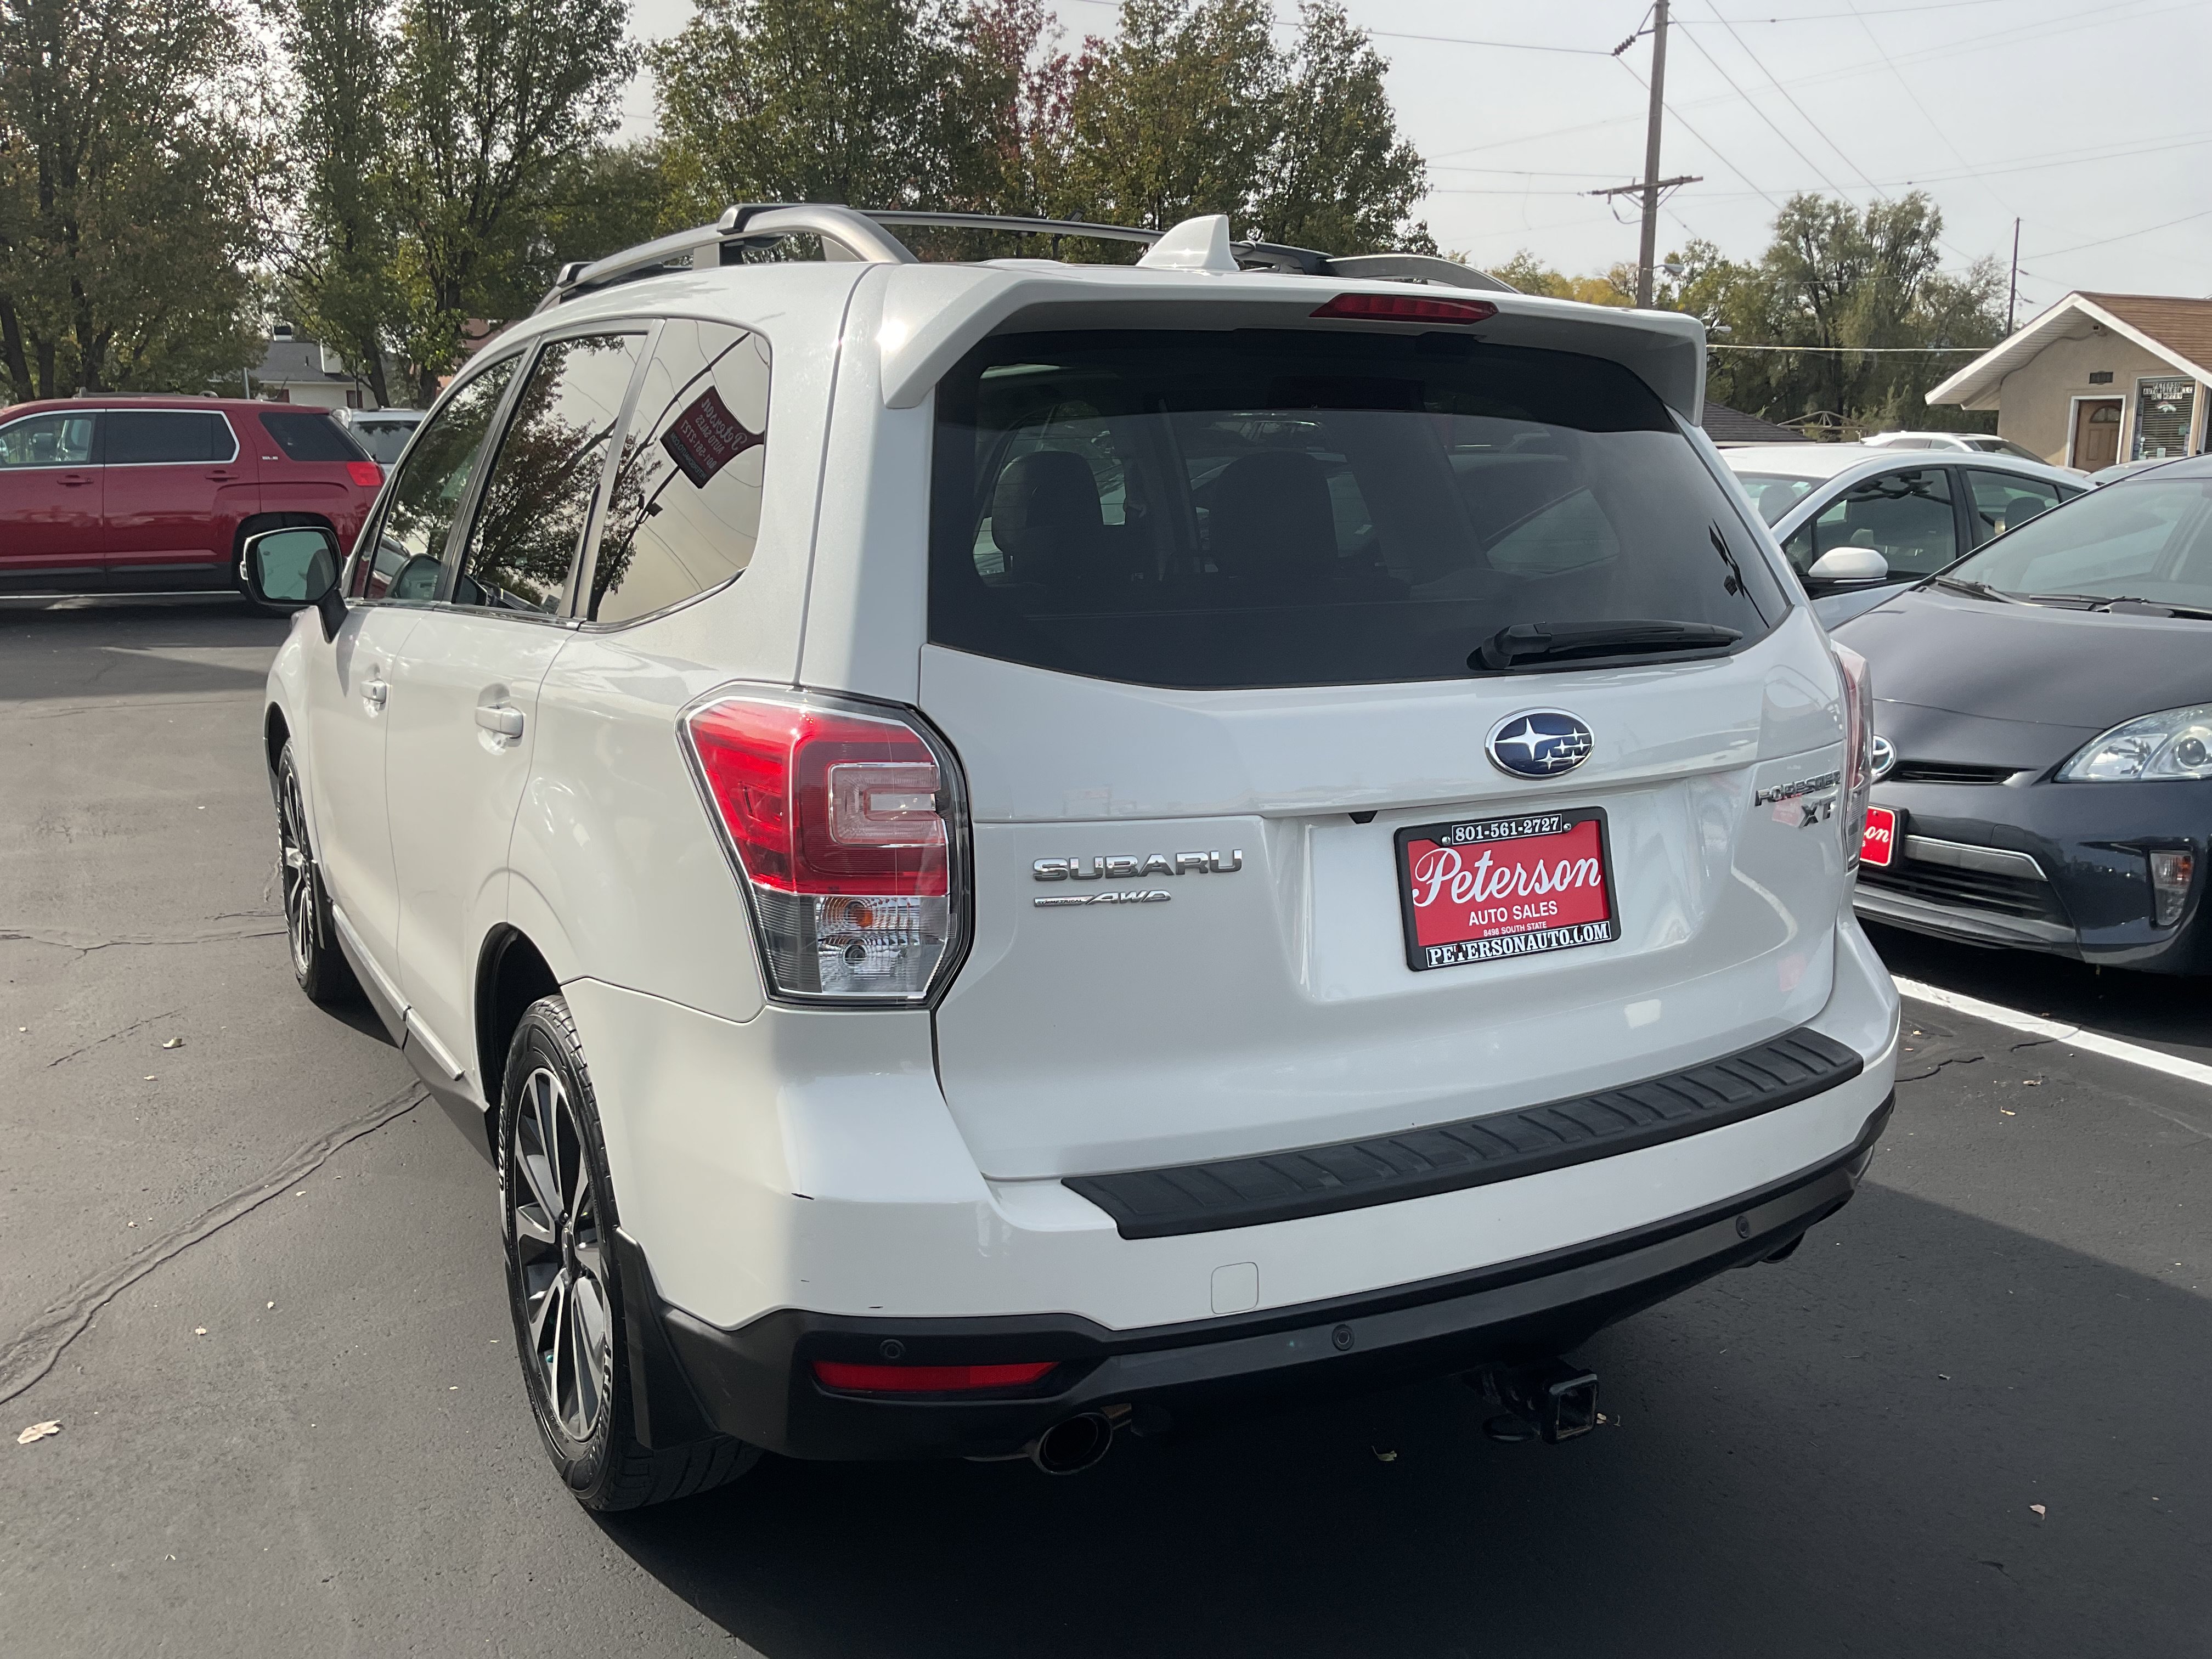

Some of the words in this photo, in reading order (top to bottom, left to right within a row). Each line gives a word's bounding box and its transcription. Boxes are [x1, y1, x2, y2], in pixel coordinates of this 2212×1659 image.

[1754, 770, 1841, 806] FORESTER
[1798, 796, 1836, 828] XT
[1454, 817, 1559, 842] 801-561-2727
[1033, 849, 1243, 882] SUBARU
[1412, 847, 1601, 907] Peterson
[1085, 889, 1172, 905] AWD
[1469, 908, 1508, 927] AUTO
[1513, 900, 1558, 921] SALES
[1483, 927, 1500, 937] 8498
[1501, 924, 1525, 934] SOUTH
[1526, 921, 1547, 932] STATE
[1429, 923, 1609, 966] PETERSONAUTO.COM
